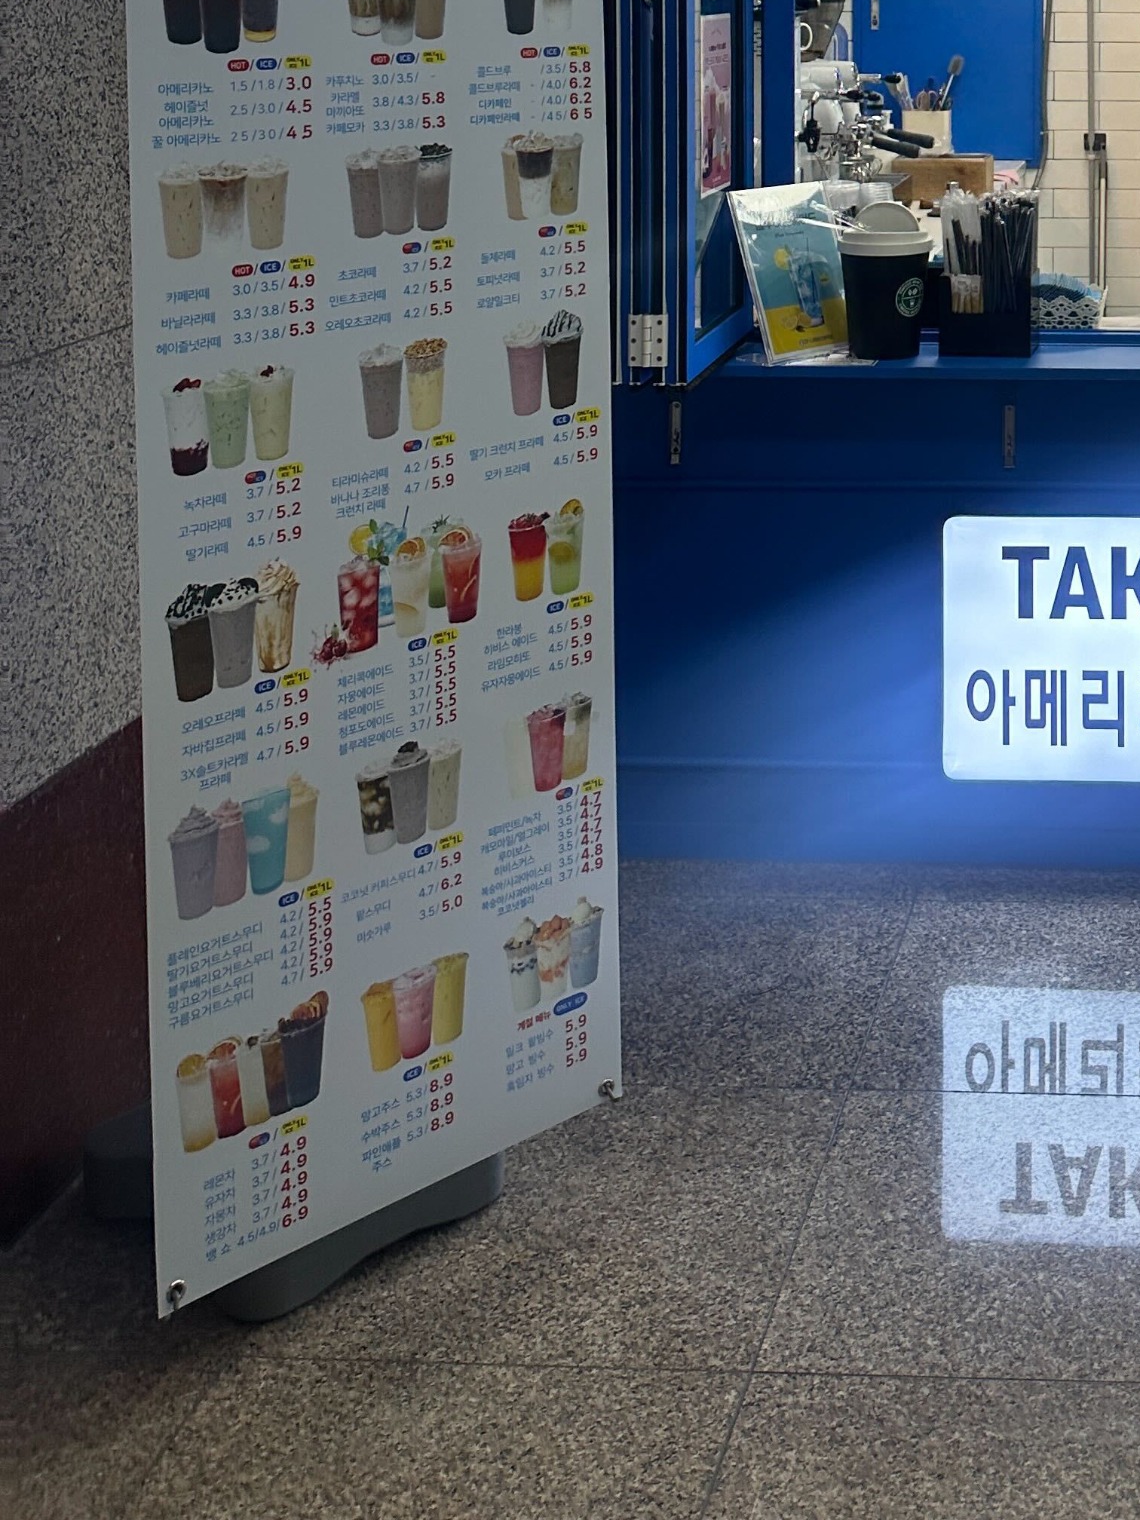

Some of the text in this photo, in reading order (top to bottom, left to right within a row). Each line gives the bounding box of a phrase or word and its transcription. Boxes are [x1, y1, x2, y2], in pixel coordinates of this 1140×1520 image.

[569, 61, 591, 73] 5.8
[158, 76, 312, 96] 아메리카노 3.0
[569, 77, 592, 89] 6.2
[421, 91, 446, 105] 5.8
[569, 92, 592, 105] 6.2
[164, 99, 312, 114] 헤이즐넛 4.5
[158, 117, 215, 131] 아메리카노
[421, 115, 446, 129] 5.3
[167, 132, 221, 147] 아메리카노
[564, 240, 586, 254] 5.5
[429, 256, 452, 271] 5.2
[288, 274, 315, 289] 4.9
[430, 278, 452, 293] 5.5
[565, 283, 586, 297] 5.2
[289, 298, 315, 313] 5.3
[289, 321, 315, 336] 5.3
[431, 453, 454, 469] 5.5
[276, 478, 301, 495] 5.2
[431, 473, 455, 490] 5.9
[277, 525, 302, 543] 5.9
[570, 614, 593, 631] 5.9
[283, 688, 309, 707] 5.9
[565, 1014, 587, 1033] 5.9
[429, 1072, 453, 1093] 8.9
[430, 1092, 454, 1112] 8.9
